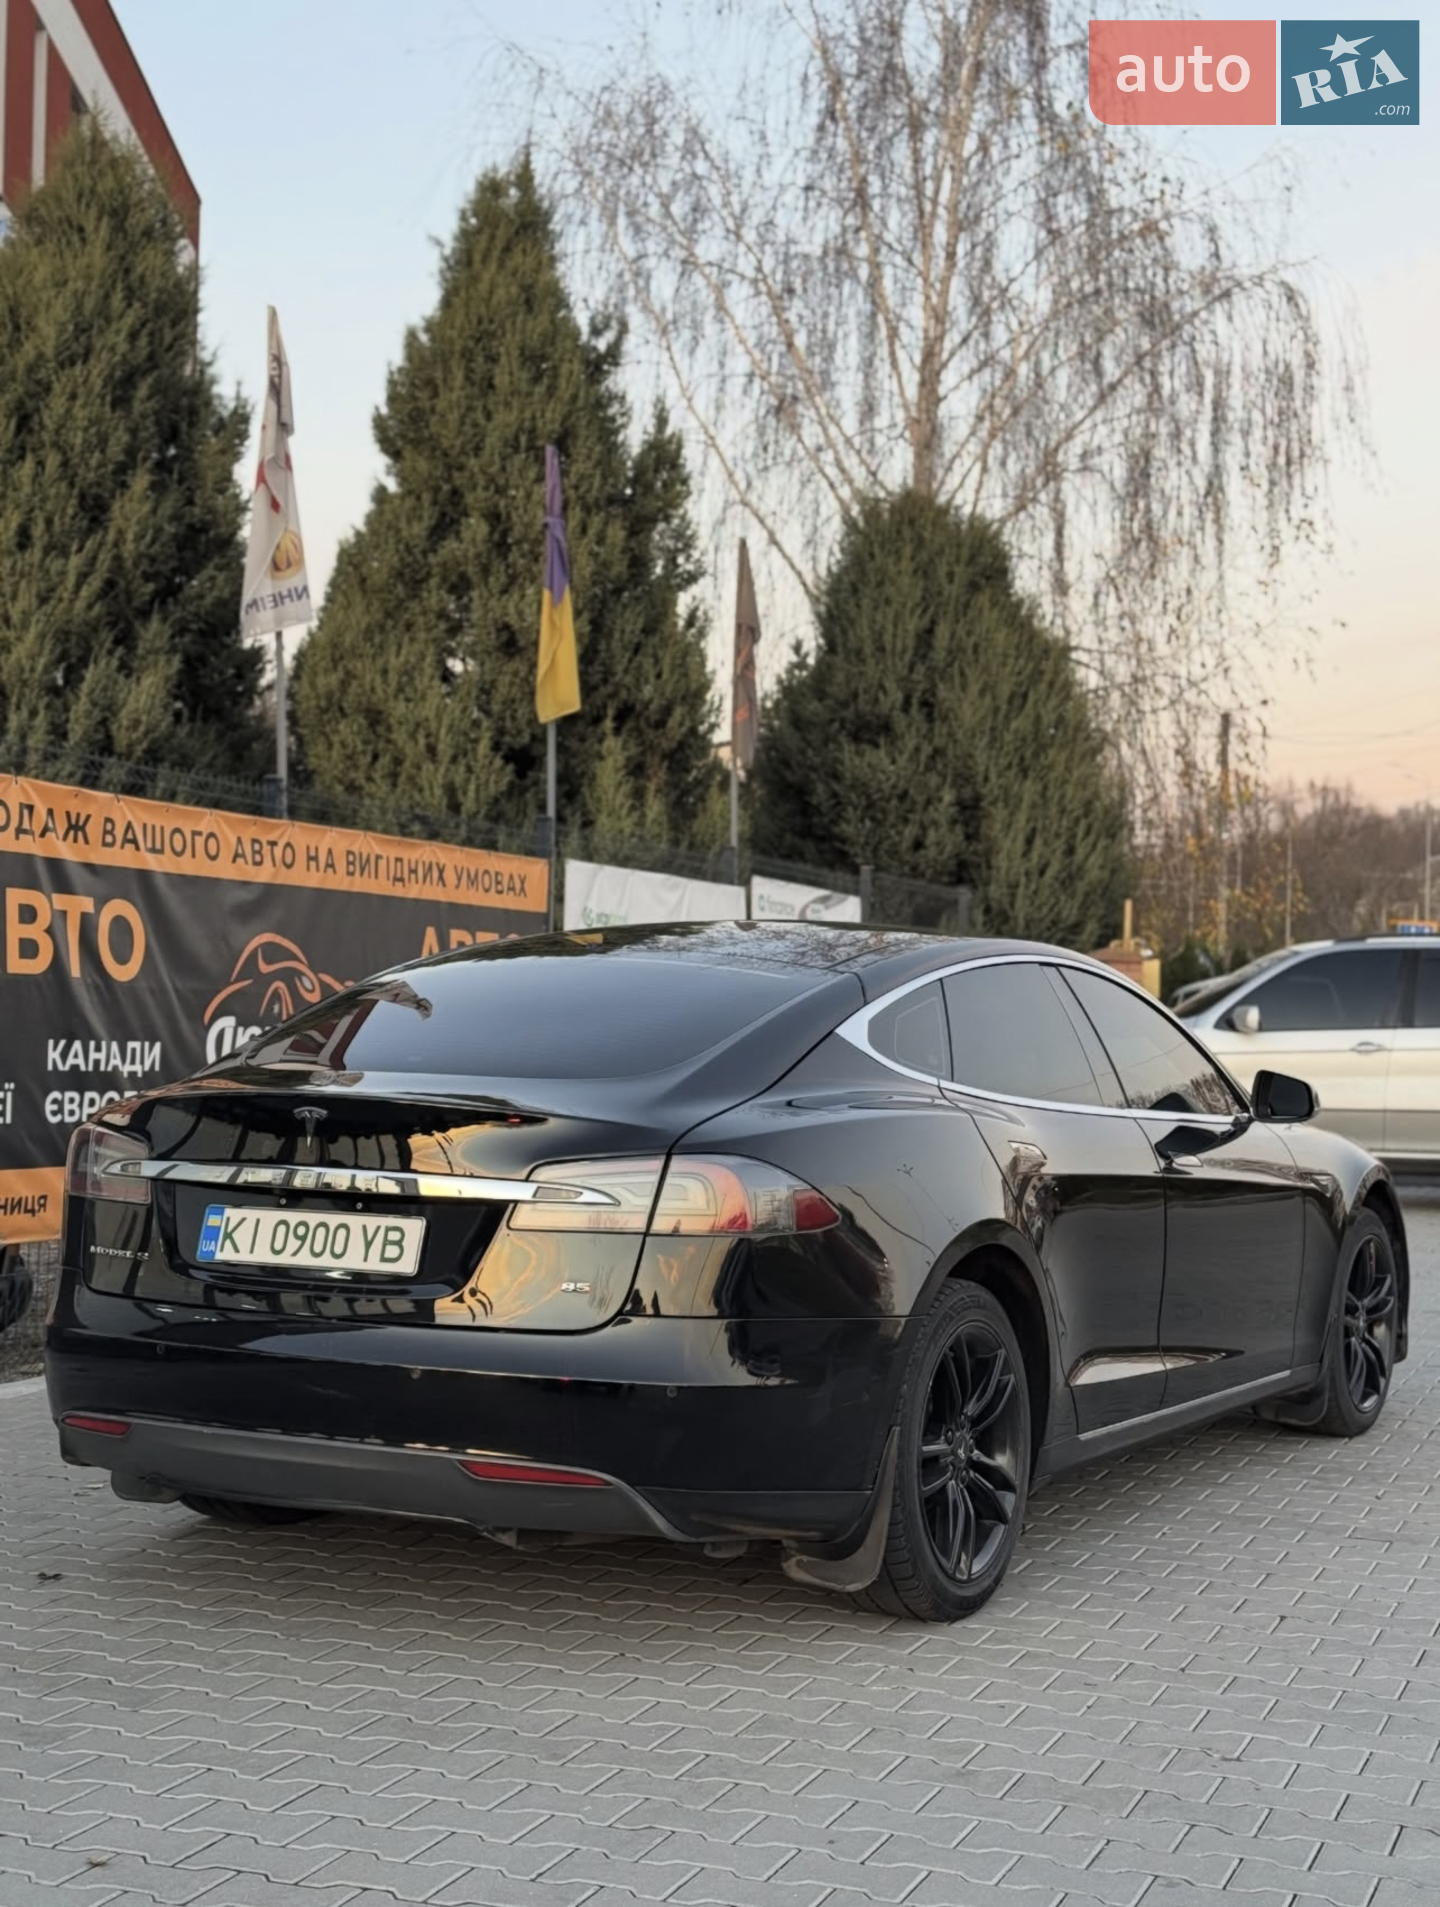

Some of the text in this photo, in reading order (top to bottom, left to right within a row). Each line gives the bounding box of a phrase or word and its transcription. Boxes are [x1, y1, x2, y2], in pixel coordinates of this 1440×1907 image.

[101, 816, 221, 862] ВАШОГО
[231, 836, 296, 869] АВТО
[306, 845, 337, 875] НА
[345, 851, 447, 888] ВИГІДНИХ
[454, 865, 528, 898] УМОВАХ
[5, 887, 146, 982] ВТО
[47, 1039, 162, 1078] КАНАДИ
[202, 1240, 216, 1252] UA
[219, 1216, 406, 1264] KI 0900 YB
